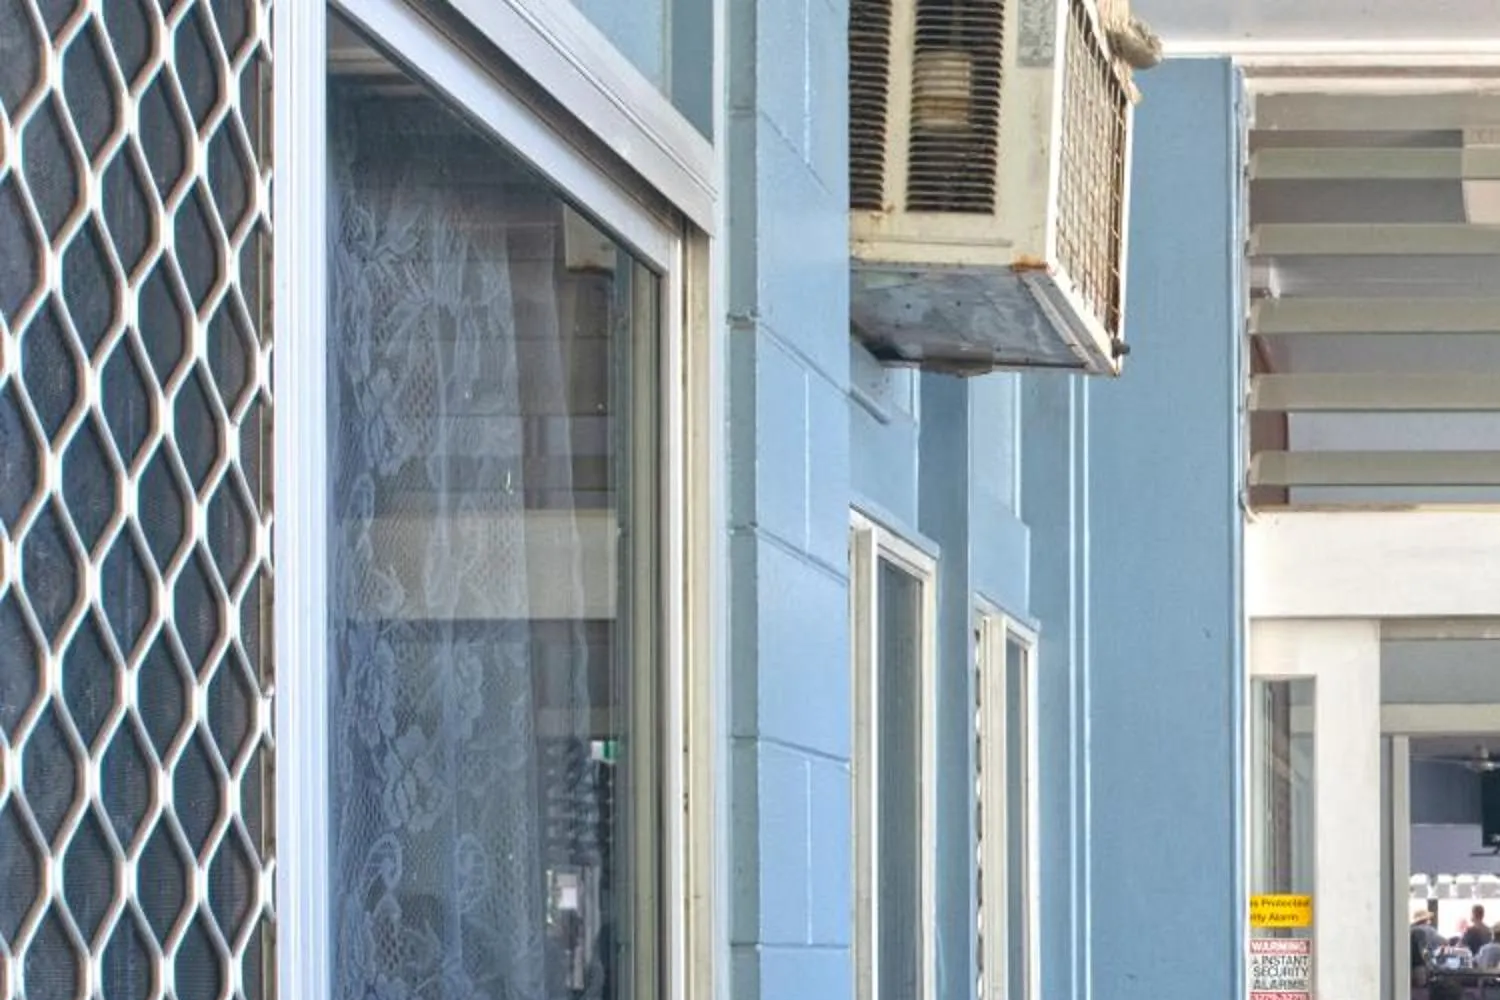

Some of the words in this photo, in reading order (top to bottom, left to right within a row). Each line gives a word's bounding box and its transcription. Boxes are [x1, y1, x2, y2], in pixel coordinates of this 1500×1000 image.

[1268, 911, 1299, 922] Alarm
[1251, 941, 1307, 951] WARNING
[1261, 955, 1309, 966] INSTANT
[1253, 965, 1309, 978] SECURITY
[1253, 979, 1306, 991] ALARMS
